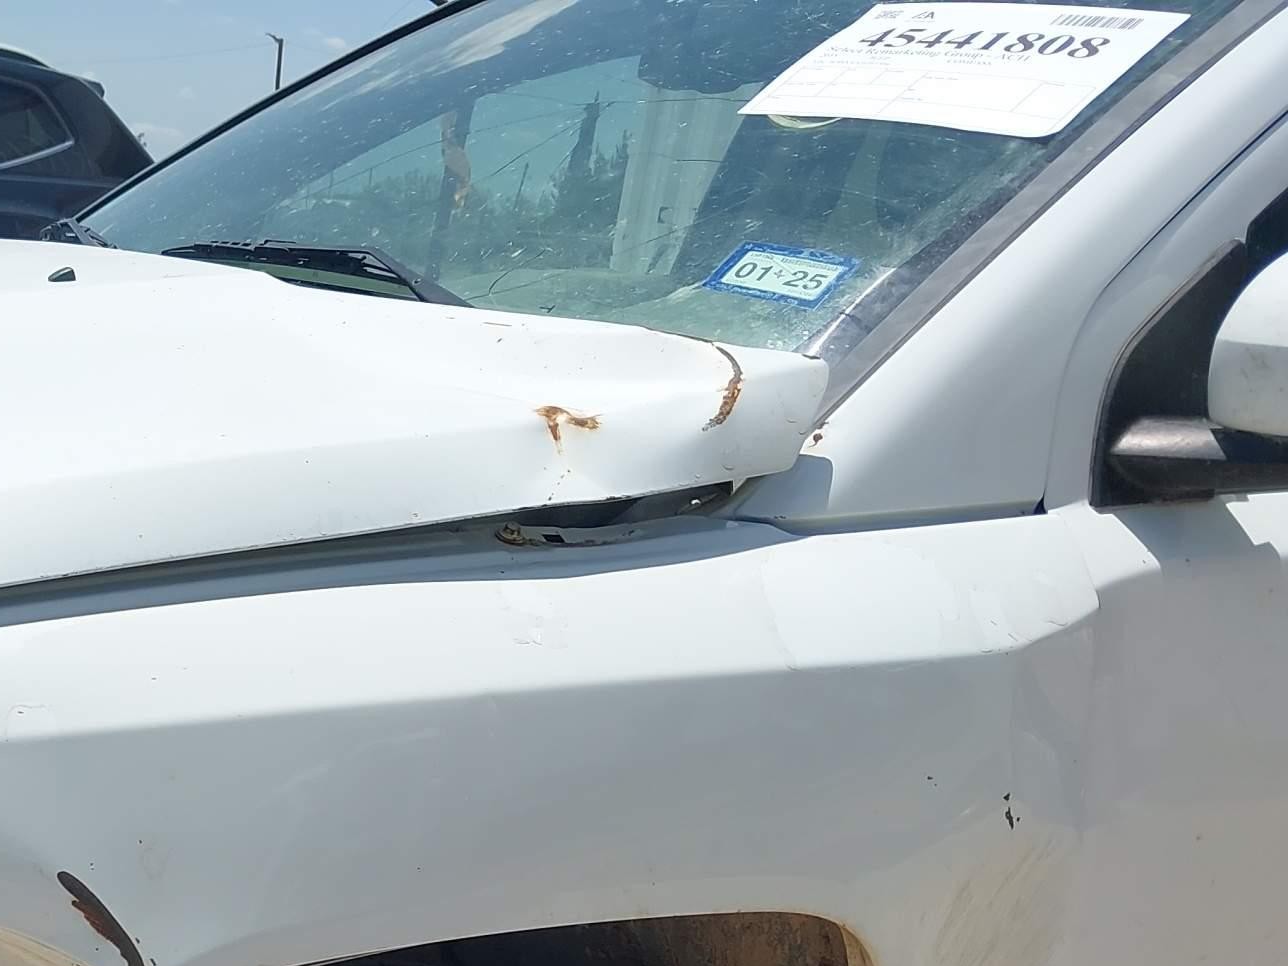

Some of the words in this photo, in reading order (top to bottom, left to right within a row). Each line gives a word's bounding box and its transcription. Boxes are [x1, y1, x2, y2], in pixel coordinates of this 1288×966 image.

[859, 27, 1111, 59] 45441808
[734, 262, 773, 281] 01
[782, 270, 828, 290] 25
